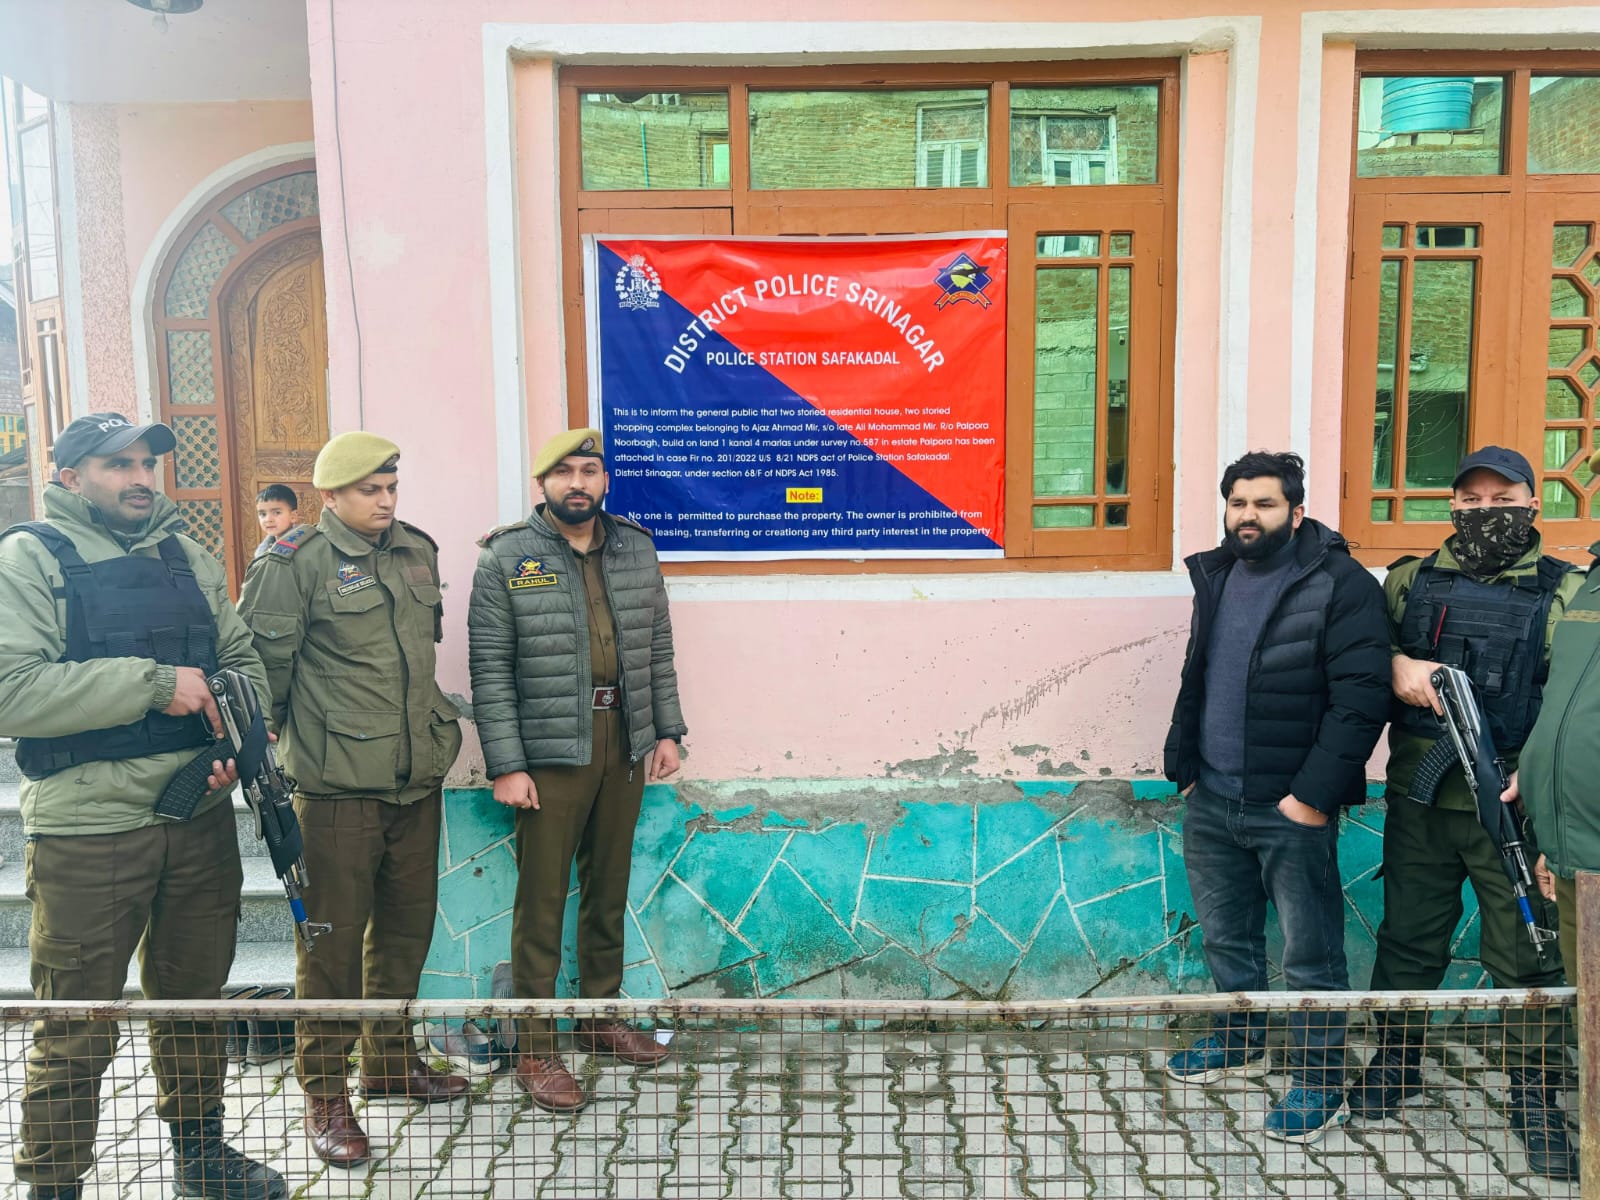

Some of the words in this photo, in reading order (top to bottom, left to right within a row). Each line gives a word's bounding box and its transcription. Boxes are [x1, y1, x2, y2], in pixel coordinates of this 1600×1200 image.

[663, 286, 750, 375] DISTRICT
[755, 273, 839, 302] POLICE
[845, 281, 945, 374] SRINAGAR
[706, 352, 756, 366] POLICE
[759, 352, 818, 366] STATION
[821, 351, 900, 366] SAFAKADAL
[613, 407, 628, 416] This
[631, 407, 638, 416] is
[640, 407, 648, 416] to
[650, 407, 678, 416] inform
[680, 407, 694, 416] the
[696, 407, 729, 418] general
[731, 407, 758, 418] public
[760, 407, 778, 416] that
[780, 407, 794, 416] two
[797, 407, 826, 416] storied
[828, 407, 872, 415] residential
[874, 407, 903, 416] house,
[904, 407, 920, 415] two
[922, 407, 950, 415] storied
[613, 423, 654, 433] shopping
[656, 423, 694, 433] complex
[695, 423, 739, 433] belonging
[741, 423, 750, 431] to
[752, 423, 770, 433] Ajaz
[772, 423, 803, 431] Ahmad
[822, 423, 835, 431] s/o
[836, 422, 853, 431] late
[855, 422, 866, 431] Ali
[868, 422, 921, 430] Mohammad
[940, 422, 954, 430] R/o
[614, 438, 660, 448] Noorbagh,
[662, 438, 684, 446] build
[699, 438, 719, 446] land
[722, 438, 726, 446] 1
[728, 438, 753, 446] kanal
[754, 438, 760, 446] 4
[762, 438, 792, 446] marlas
[793, 438, 818, 446] under
[820, 440, 848, 448] survey
[881, 438, 889, 446] in
[890, 438, 918, 446] estate
[954, 438, 970, 446] has
[972, 438, 996, 446] been
[614, 454, 655, 462] attached
[656, 454, 665, 462] in
[690, 454, 700, 462] Fir
[717, 454, 756, 462] 201/2022
[759, 453, 772, 462] U/S
[776, 453, 794, 462] 8/21
[796, 453, 819, 462] NDPS
[820, 453, 835, 462] act
[837, 453, 846, 462] of
[848, 453, 874, 462] Police
[875, 453, 905, 462] Station
[906, 453, 952, 461] Safakadal.
[615, 469, 644, 477] District
[684, 469, 710, 477] under
[712, 469, 743, 477] section
[744, 468, 763, 477] 68/F
[764, 468, 774, 477] of
[775, 468, 797, 477] NDPS
[798, 468, 814, 477] Act
[816, 468, 840, 477] 1985.
[790, 490, 819, 501] Note:
[628, 512, 642, 520] No
[664, 512, 673, 520] is
[678, 511, 723, 522] permitted
[725, 511, 736, 519] to
[737, 511, 782, 521] purchase
[784, 511, 799, 519] the
[801, 511, 844, 521] property.
[846, 511, 864, 519] The
[898, 511, 906, 519] is
[908, 510, 958, 521] prohibited
[960, 510, 983, 518] from
[655, 528, 692, 538] leasing,
[694, 528, 750, 538] transferring
[811, 530, 829, 538] any
[831, 527, 854, 536] third
[855, 527, 880, 538] party
[882, 527, 919, 535] interest
[921, 527, 930, 535] in
[932, 527, 948, 535] the
[950, 527, 992, 537] property.
[516, 577, 551, 587] RAHUL
